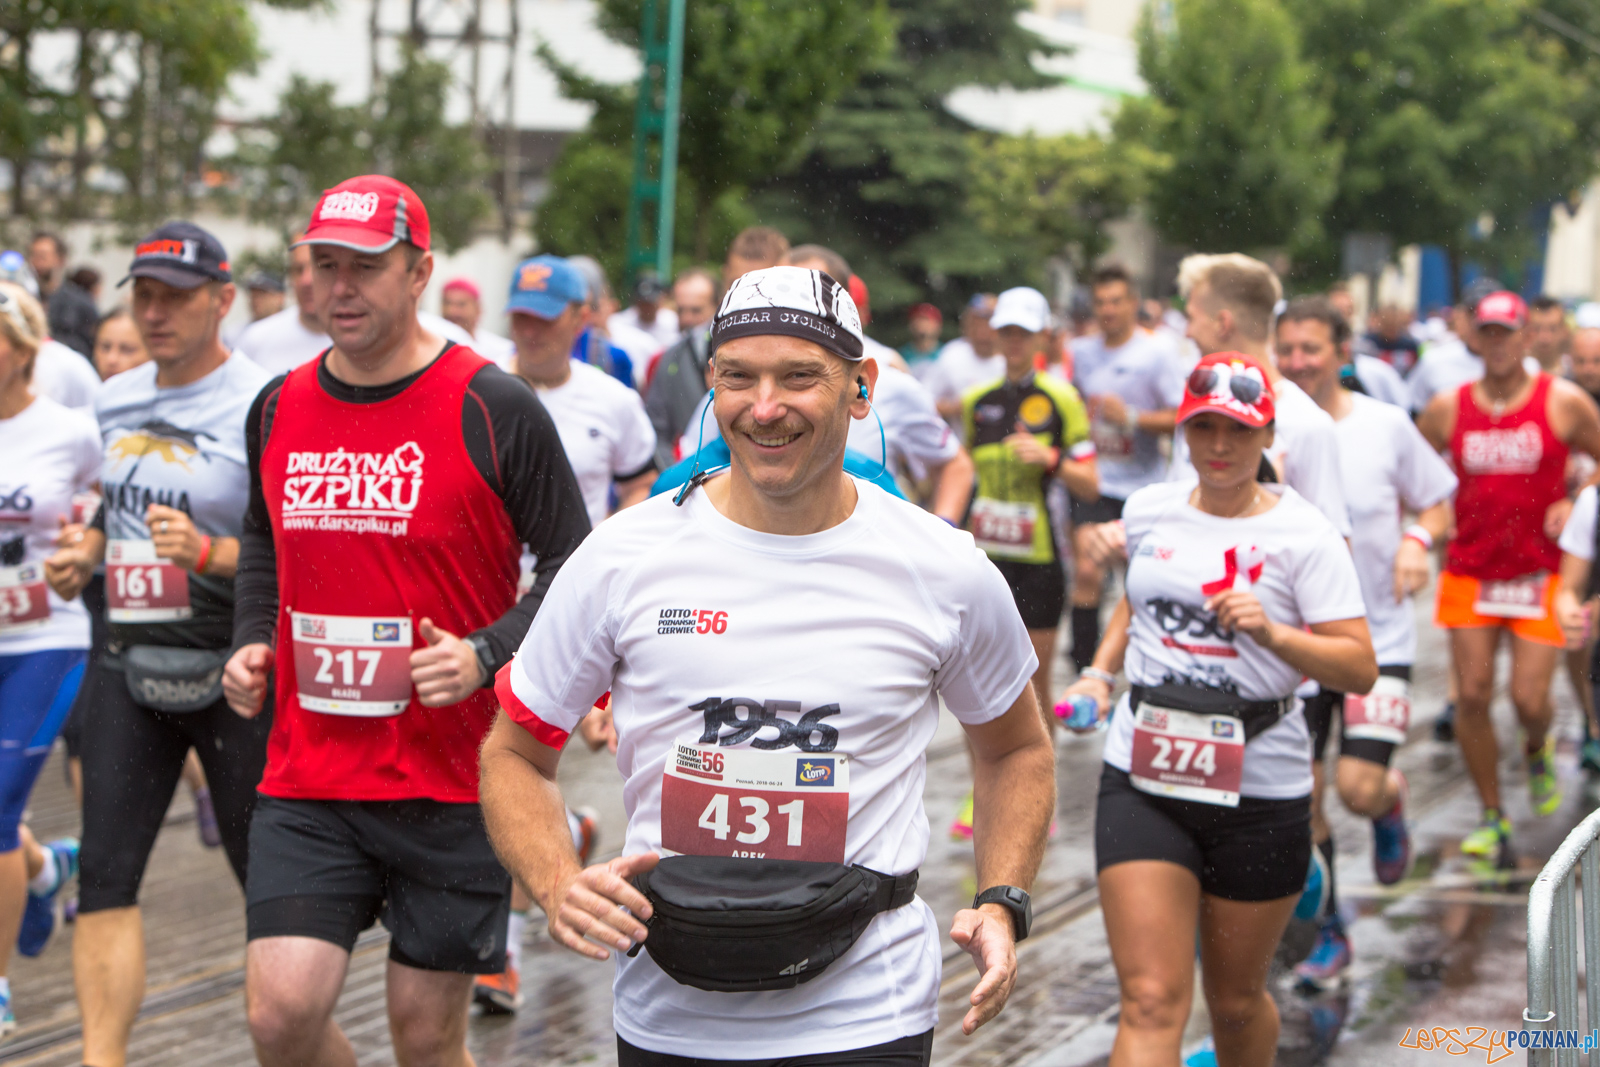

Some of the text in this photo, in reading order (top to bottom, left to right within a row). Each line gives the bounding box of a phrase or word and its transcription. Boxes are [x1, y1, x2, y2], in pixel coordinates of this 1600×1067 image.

[717, 312, 771, 334] NUCLEAR
[779, 312, 836, 339] CYCLING
[286, 446, 398, 475] DRUŻYNA
[282, 474, 423, 512] SZPIKU
[282, 515, 408, 537] www.darszpiku.pl
[114, 566, 164, 598] 161
[658, 617, 697, 627] POZNAŃSKI
[660, 608, 692, 619] LOTTO
[657, 626, 696, 635] CZERWIEC
[313, 647, 382, 686] 217
[688, 697, 841, 753] 1956
[677, 744, 698, 757] LOTTO
[1150, 736, 1217, 777] 274
[676, 759, 702, 771] CZERWIEC
[806, 768, 826, 780] LOTTO
[698, 793, 805, 847] 431
[779, 958, 809, 976] 4F
